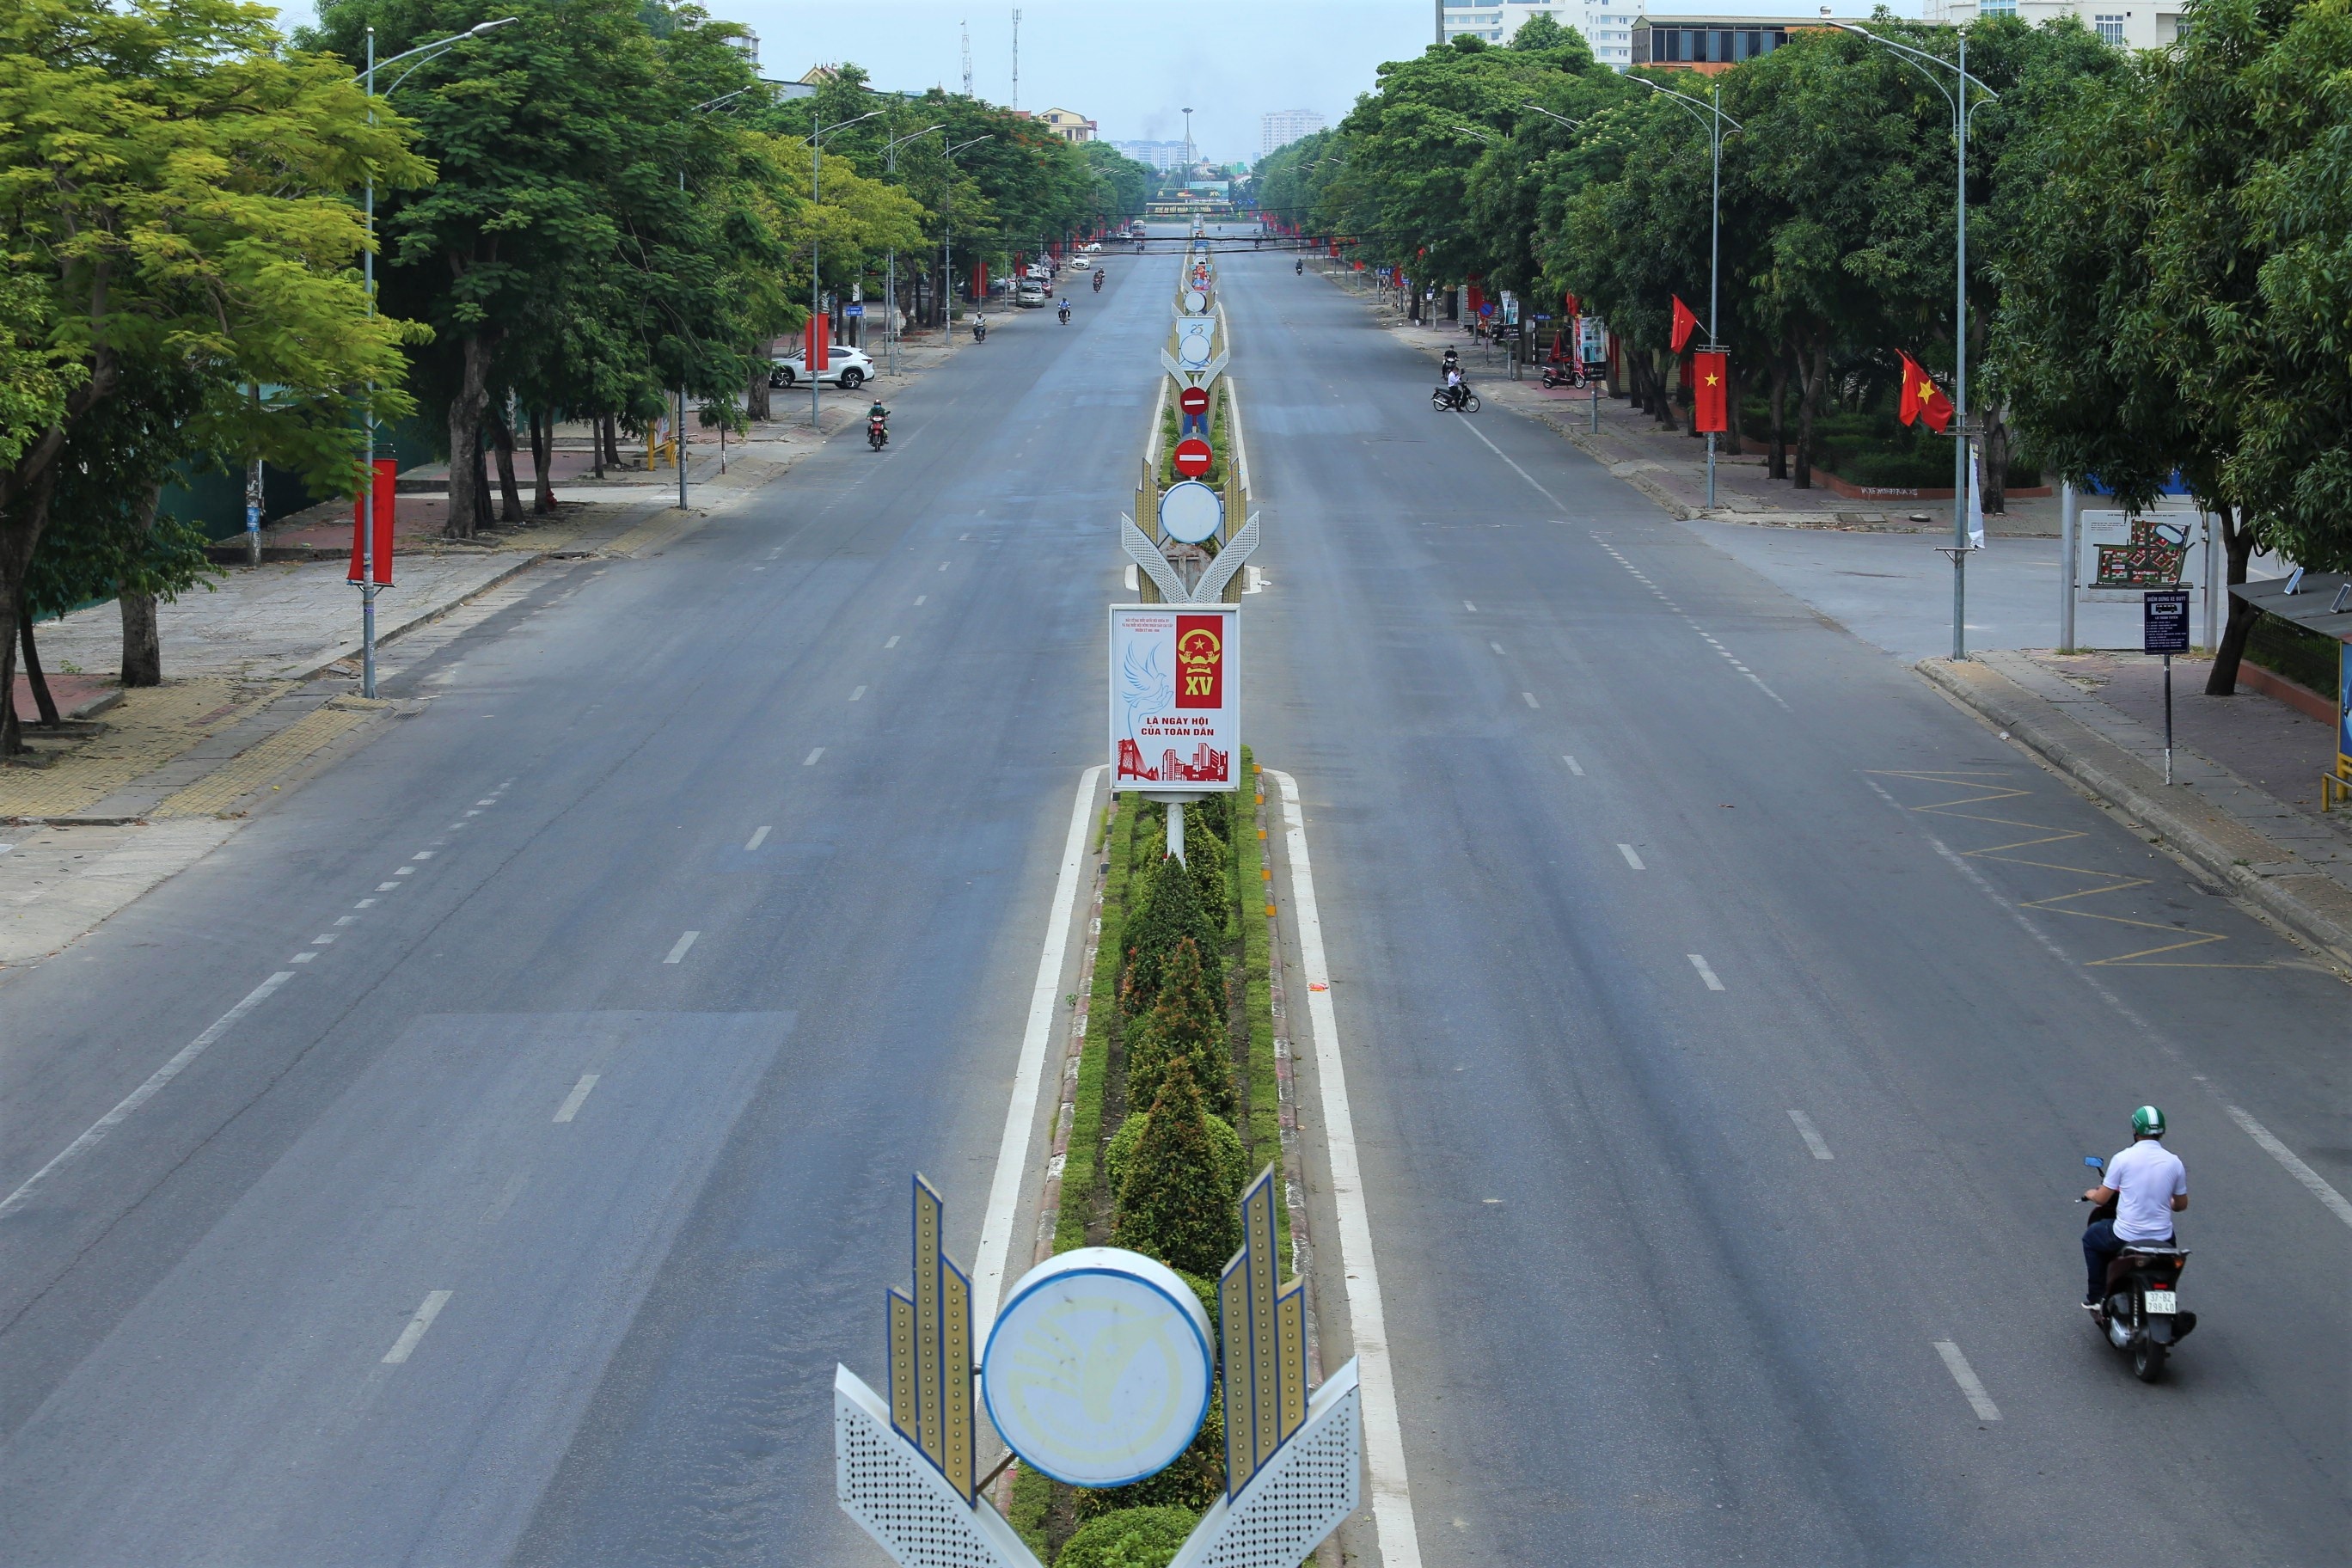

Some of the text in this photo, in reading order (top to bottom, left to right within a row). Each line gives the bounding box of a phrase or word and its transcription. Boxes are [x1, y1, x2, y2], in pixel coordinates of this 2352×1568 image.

[1191, 323, 1204, 334] 25
[1185, 676, 1213, 695] XV
[1146, 716, 1209, 726] LÀ NGÀY HỘI
[1141, 726, 1214, 736] CỦA TOÀN DÂN
